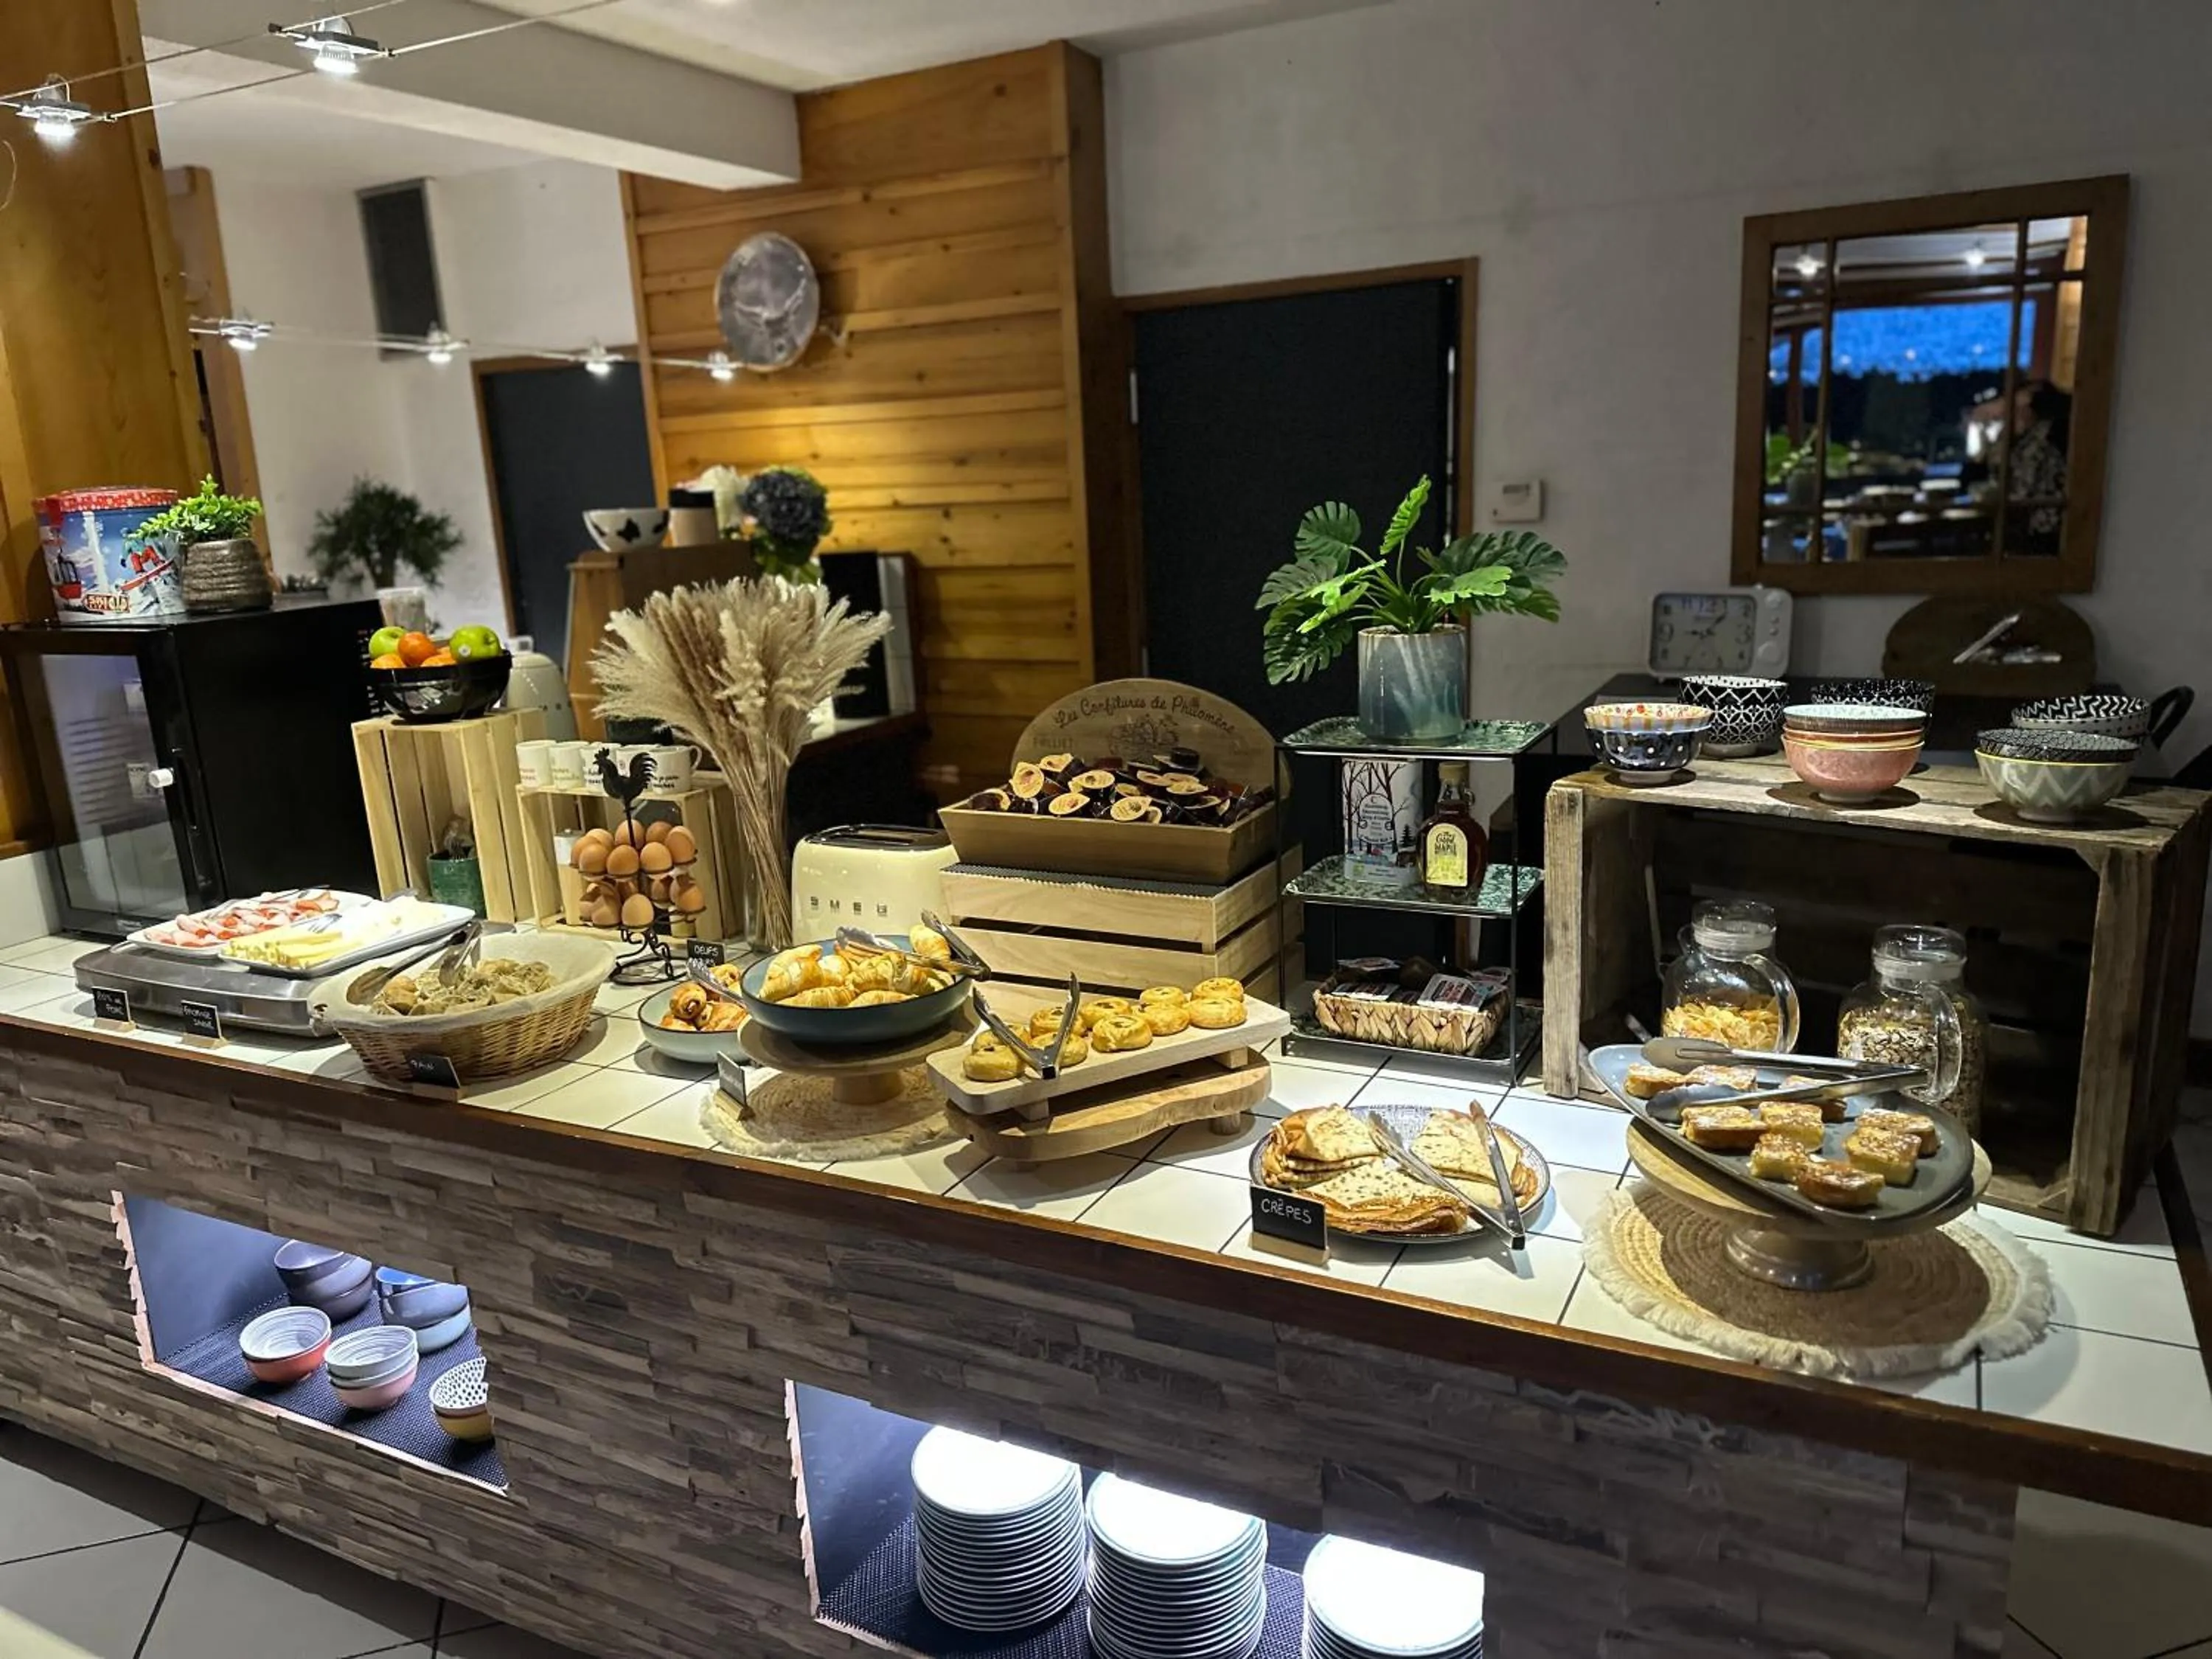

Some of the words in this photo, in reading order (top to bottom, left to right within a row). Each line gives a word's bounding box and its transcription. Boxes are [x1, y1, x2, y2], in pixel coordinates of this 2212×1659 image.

[1053, 710, 1078, 728] Les
[1080, 696, 1147, 716] Confitures
[1150, 696, 1167, 710] de
[810, 895, 888, 914] SMEG
[1260, 1197, 1313, 1225] CRÊPES
